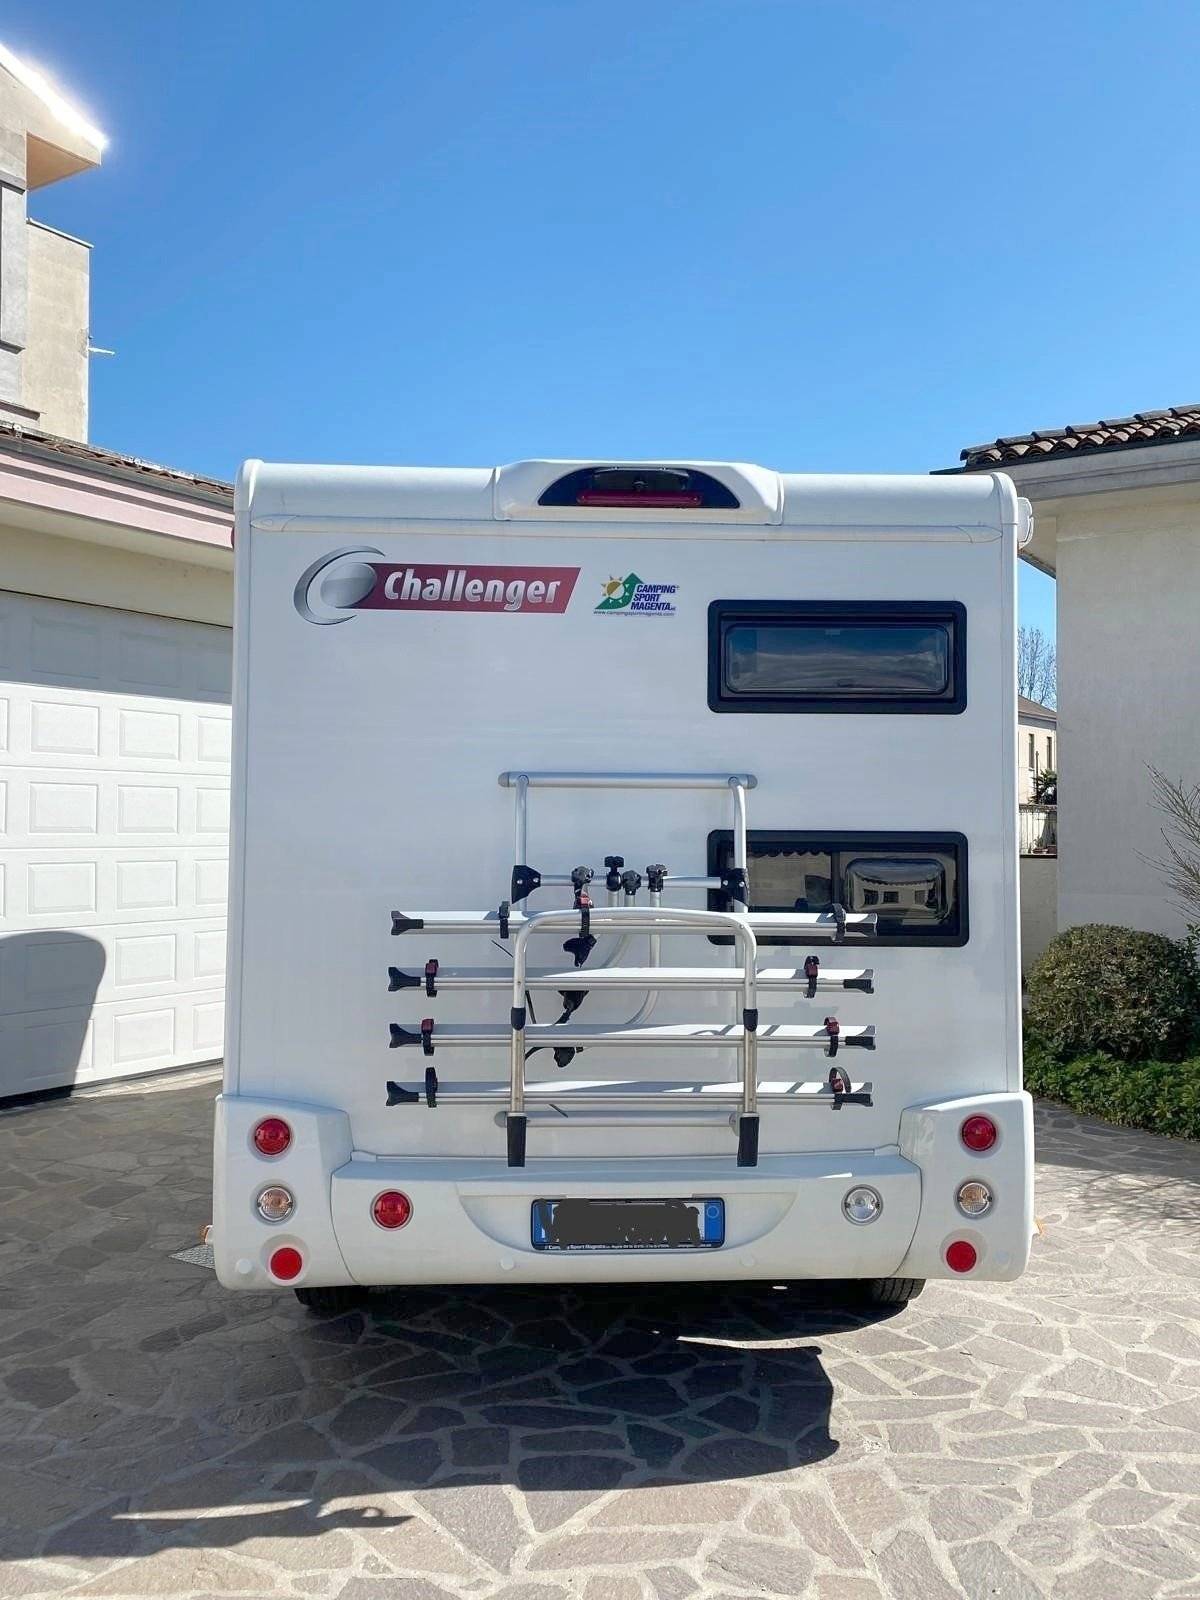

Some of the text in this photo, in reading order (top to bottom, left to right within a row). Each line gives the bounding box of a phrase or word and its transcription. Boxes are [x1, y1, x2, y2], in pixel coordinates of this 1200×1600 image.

[383, 569, 561, 611] Challenger
[636, 585, 675, 594] CAMPING
[633, 594, 661, 602] SPORT
[630, 602, 671, 611] MAGENTA
